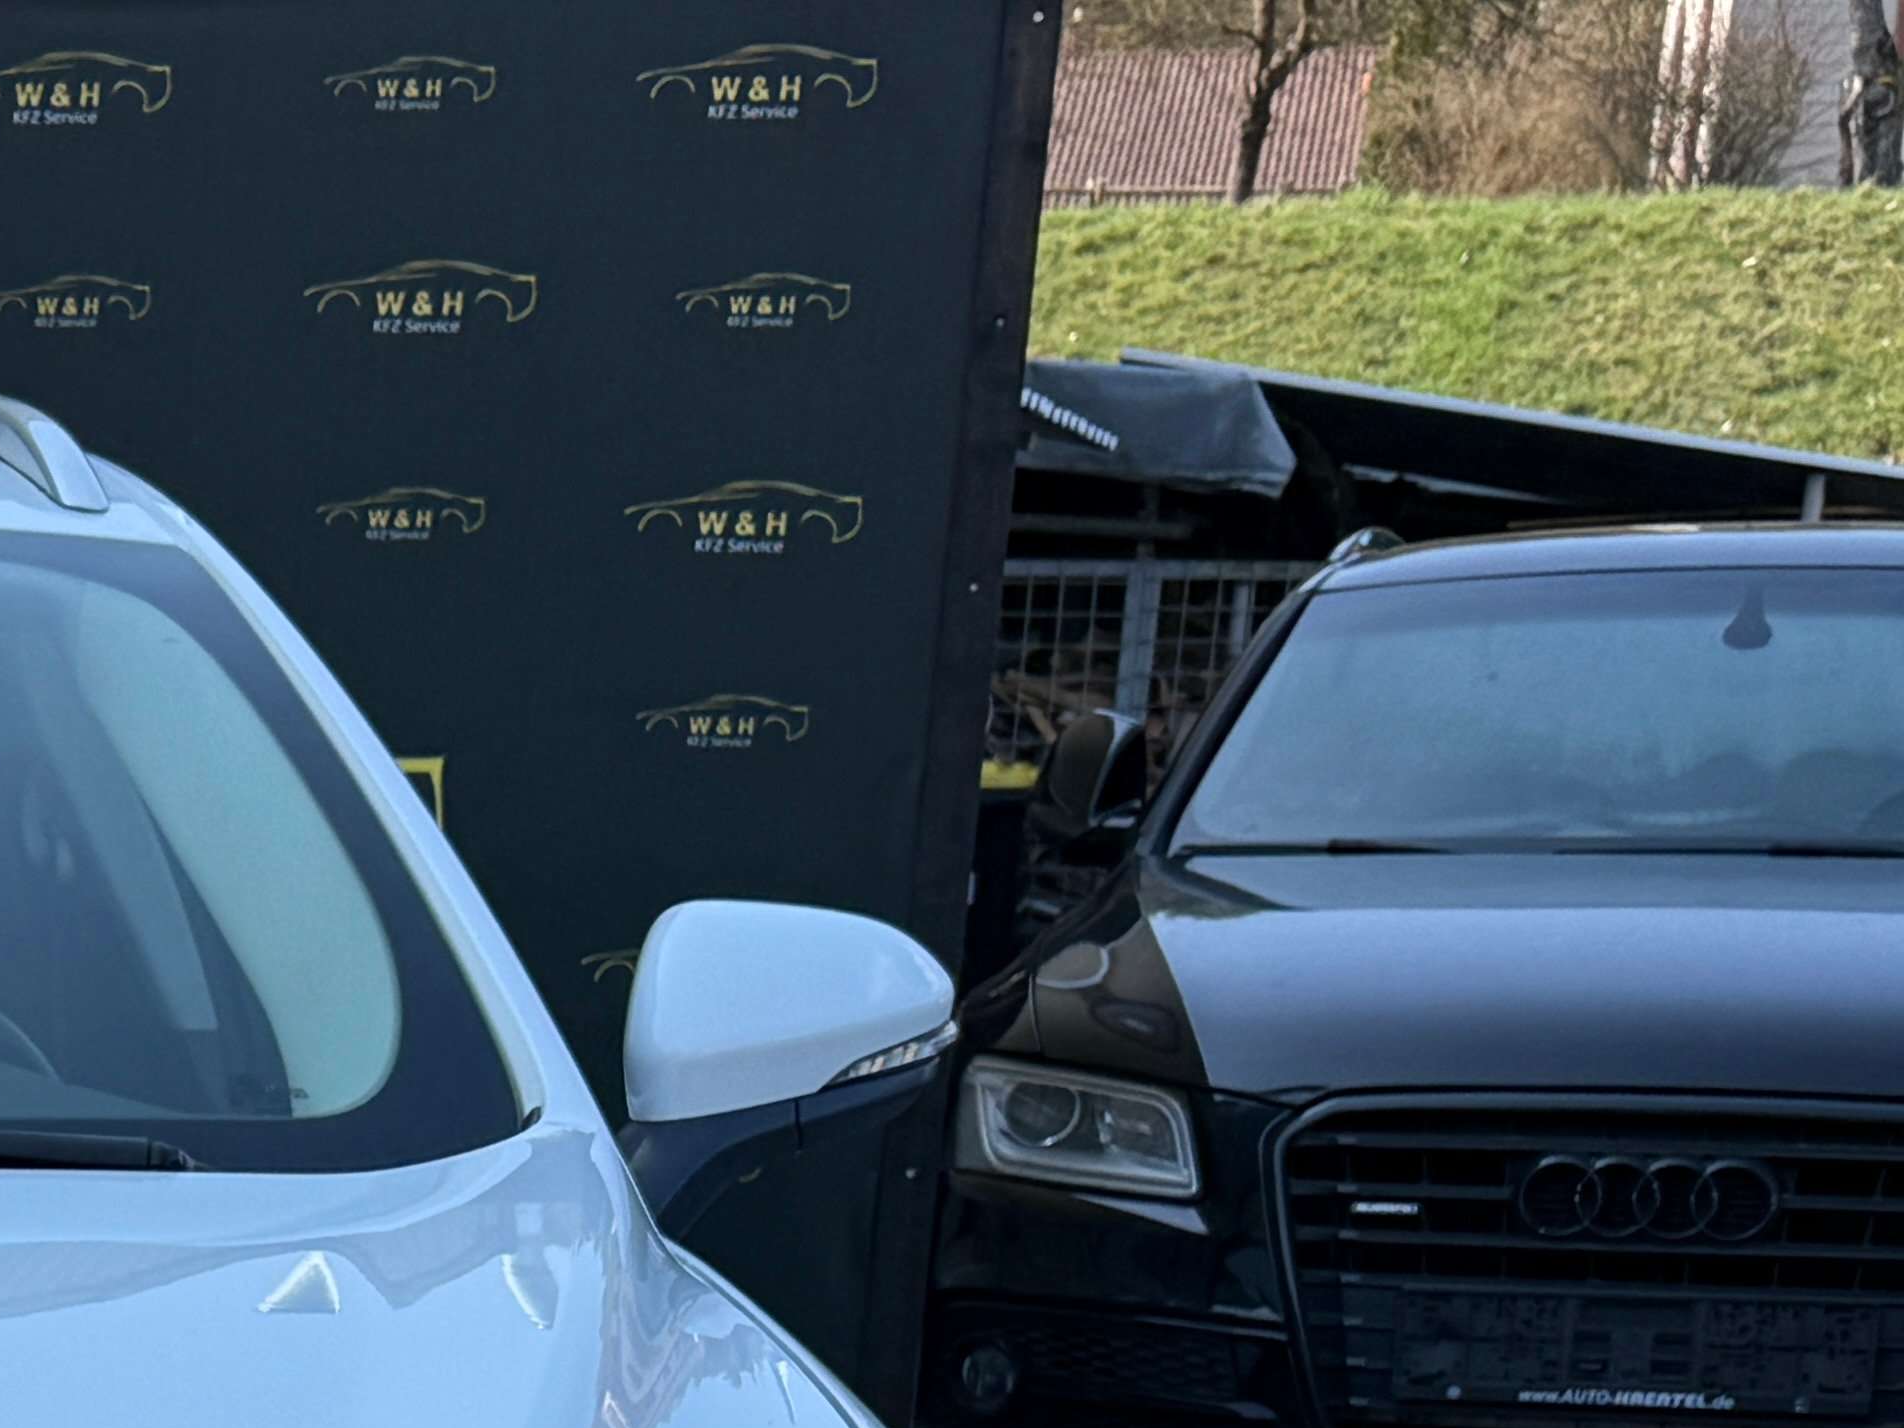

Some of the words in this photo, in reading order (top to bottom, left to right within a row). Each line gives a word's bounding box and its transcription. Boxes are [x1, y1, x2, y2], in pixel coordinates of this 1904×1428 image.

[15, 83, 44, 107] W
[50, 82, 70, 107] &
[79, 82, 100, 107] H
[377, 78, 400, 98] W
[403, 78, 420, 99] &
[424, 78, 443, 98] H
[711, 78, 741, 102] W
[748, 76, 770, 102] &
[779, 75, 801, 101] H
[36, 297, 59, 316] W
[61, 296, 79, 317] &
[82, 296, 100, 316] H
[376, 291, 405, 316] W
[411, 291, 433, 316] &
[441, 291, 463, 316] H
[729, 296, 753, 315] W
[755, 295, 774, 316] &
[778, 296, 797, 315] H
[367, 509, 391, 529] W
[392, 508, 411, 530] &
[414, 510, 433, 529] H
[698, 511, 728, 536] W
[735, 511, 755, 536] &
[765, 512, 787, 536] H
[688, 717, 713, 736] W
[716, 717, 732, 736] &
[737, 718, 756, 736] H
